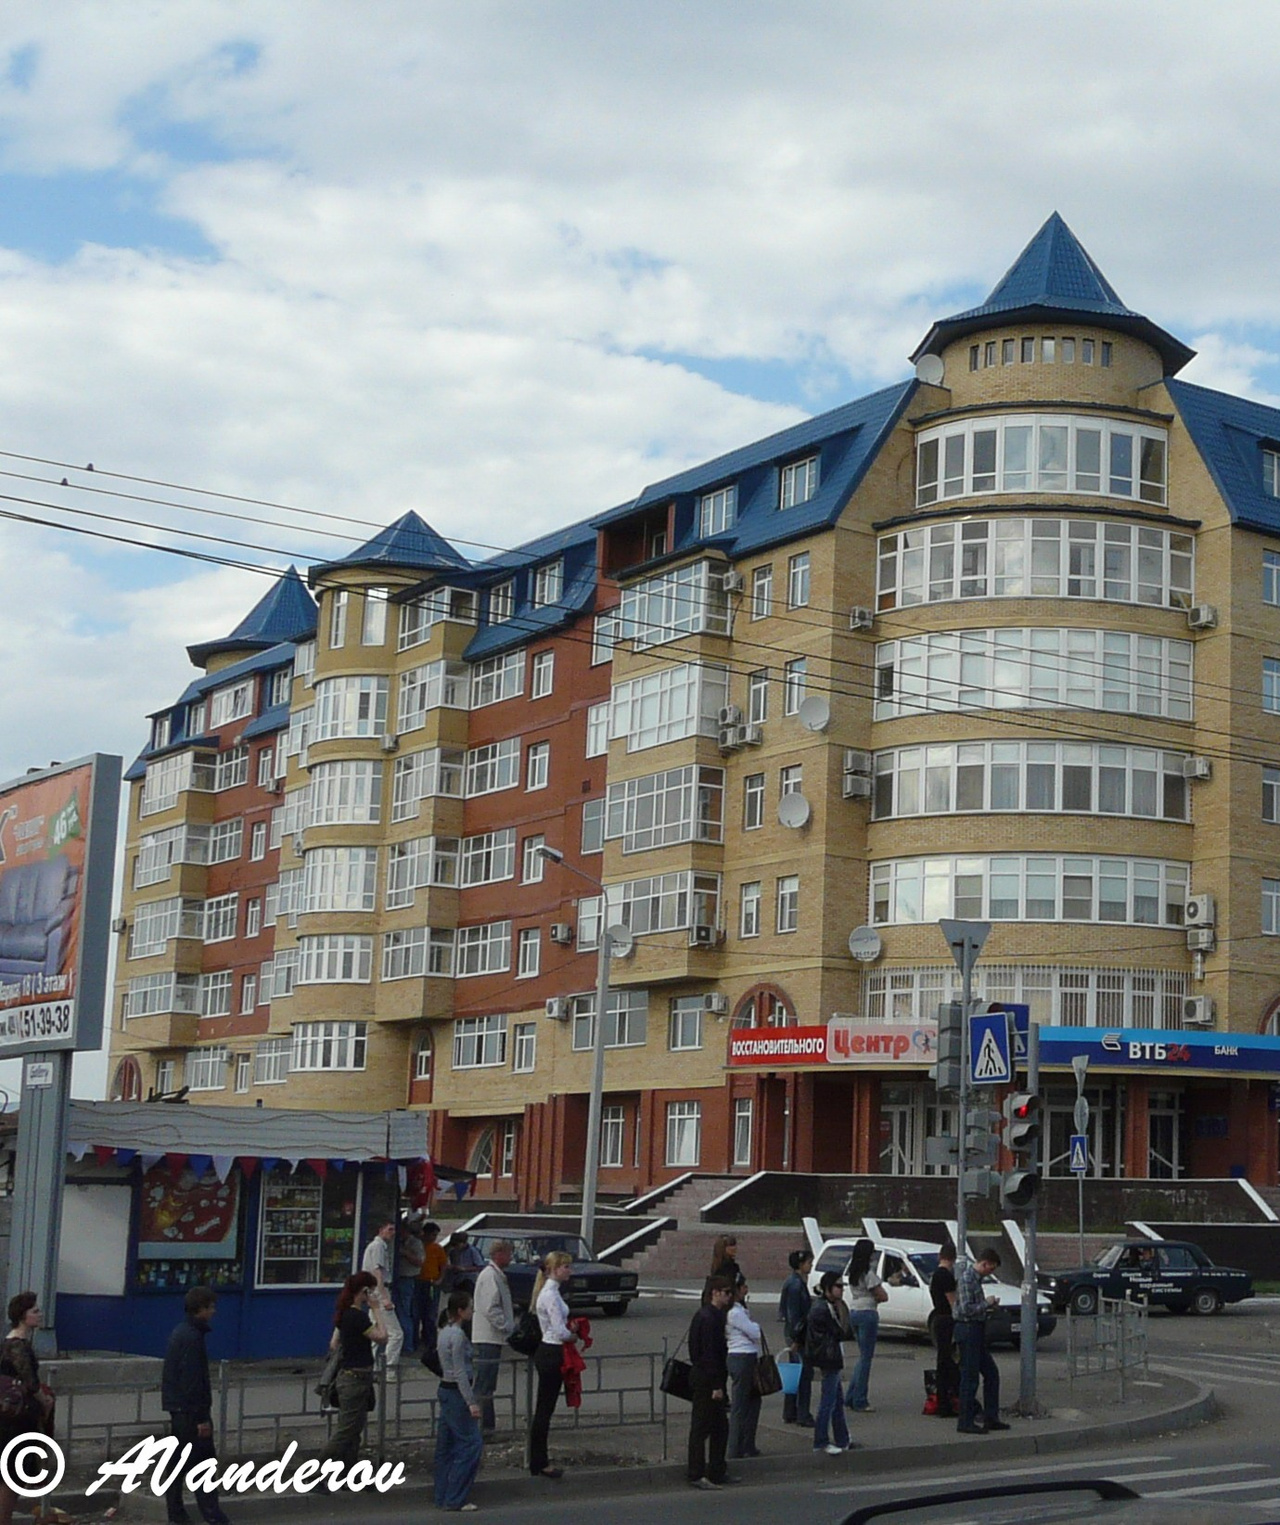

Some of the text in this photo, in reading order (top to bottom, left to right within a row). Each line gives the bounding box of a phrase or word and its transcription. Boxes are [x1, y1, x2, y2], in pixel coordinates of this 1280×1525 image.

[732, 1038, 825, 1056] ВОССТАНОВИТЕЛЬНОГО
[834, 1030, 911, 1059] Центр
[1214, 1045, 1238, 1056] БАНК
